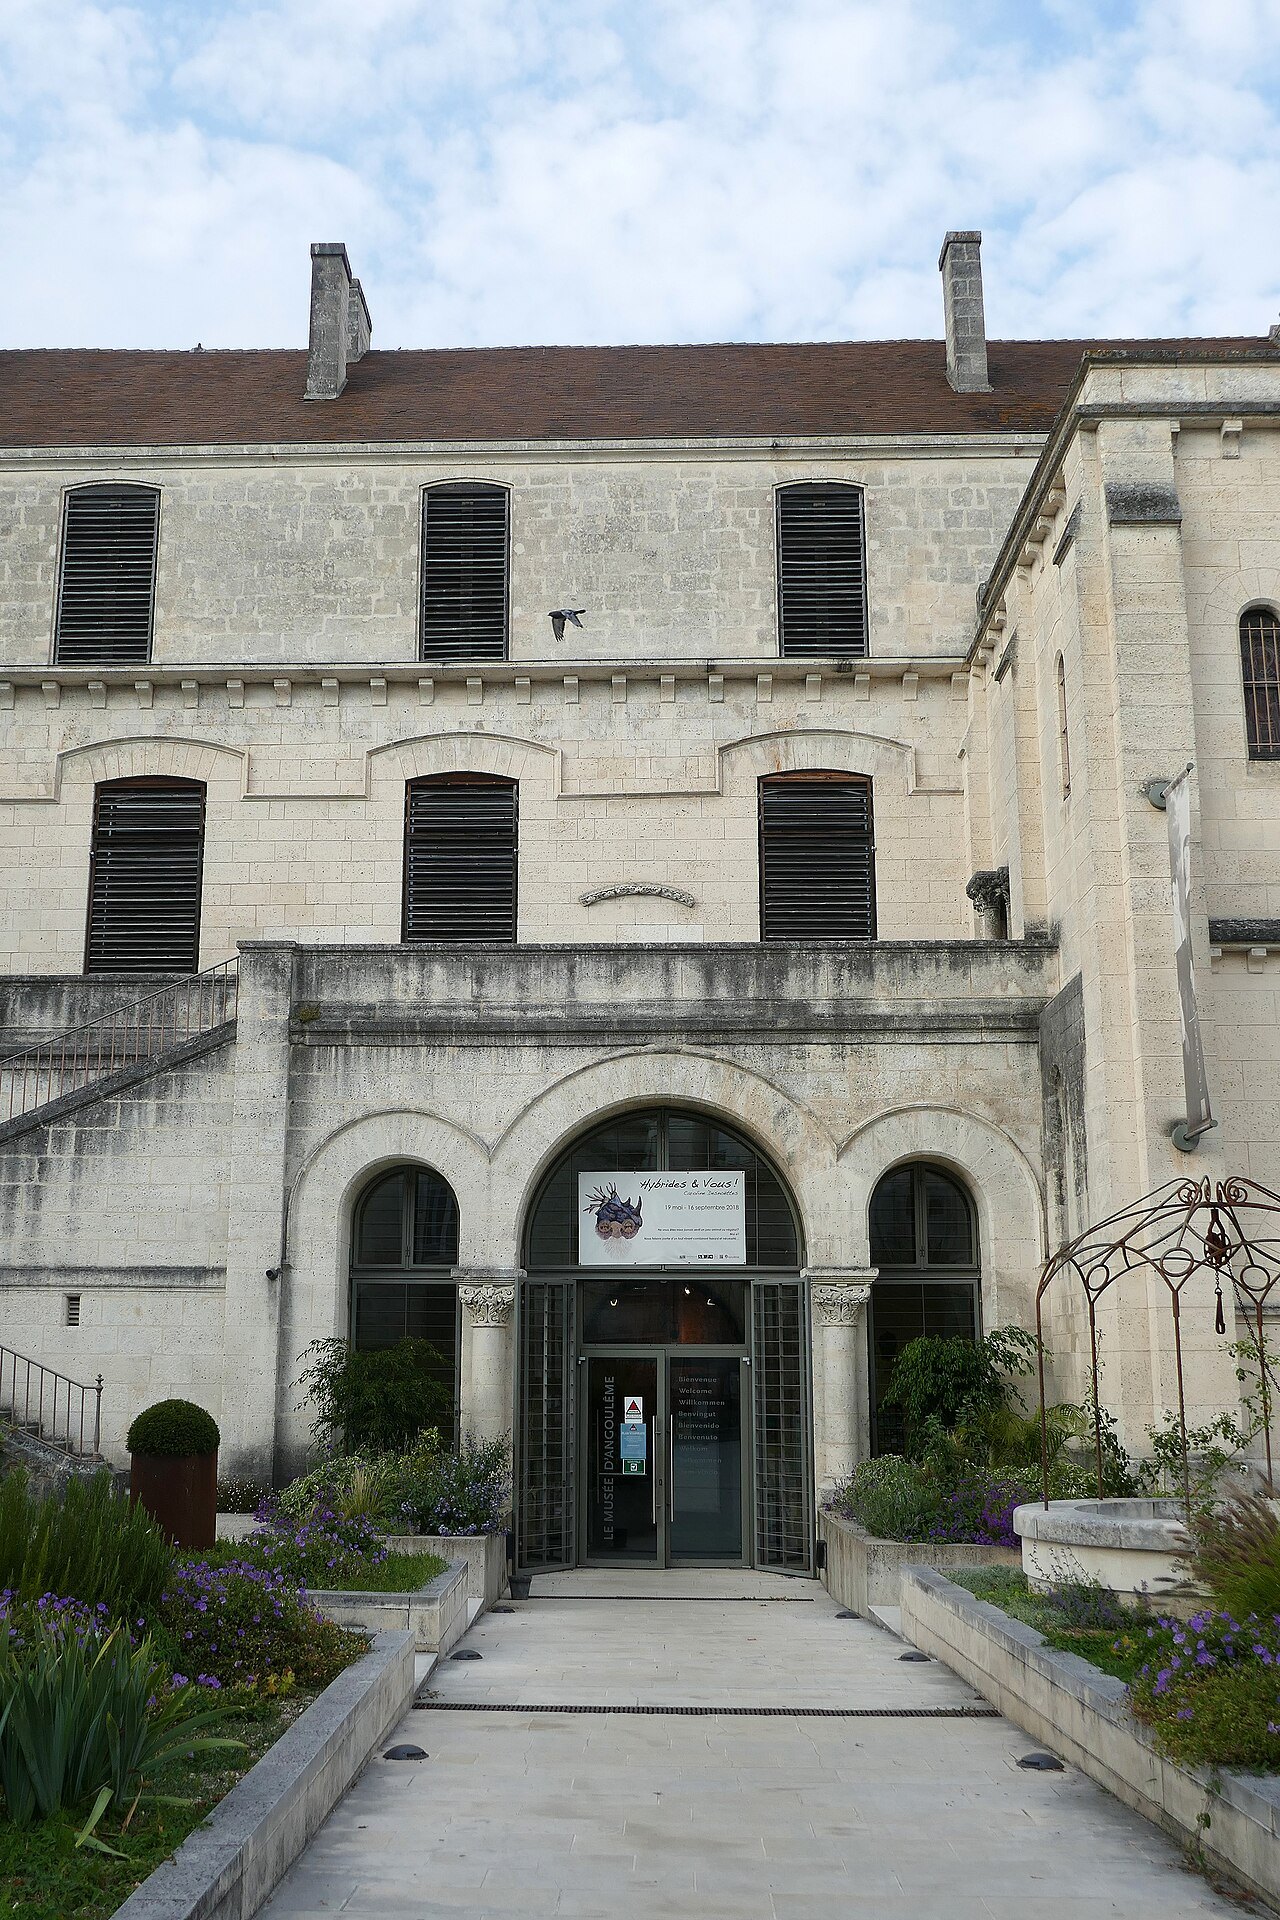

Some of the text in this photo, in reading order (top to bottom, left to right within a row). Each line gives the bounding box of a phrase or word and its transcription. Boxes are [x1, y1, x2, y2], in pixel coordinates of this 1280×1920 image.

[640, 1178, 687, 1192] Hybrides
[691, 1179, 699, 1188] &
[695, 1204, 725, 1212] septembre
[678, 1410, 716, 1418] Benvingut
[601, 1375, 615, 1540] LE MUSÉE D'ANGOULÊME
